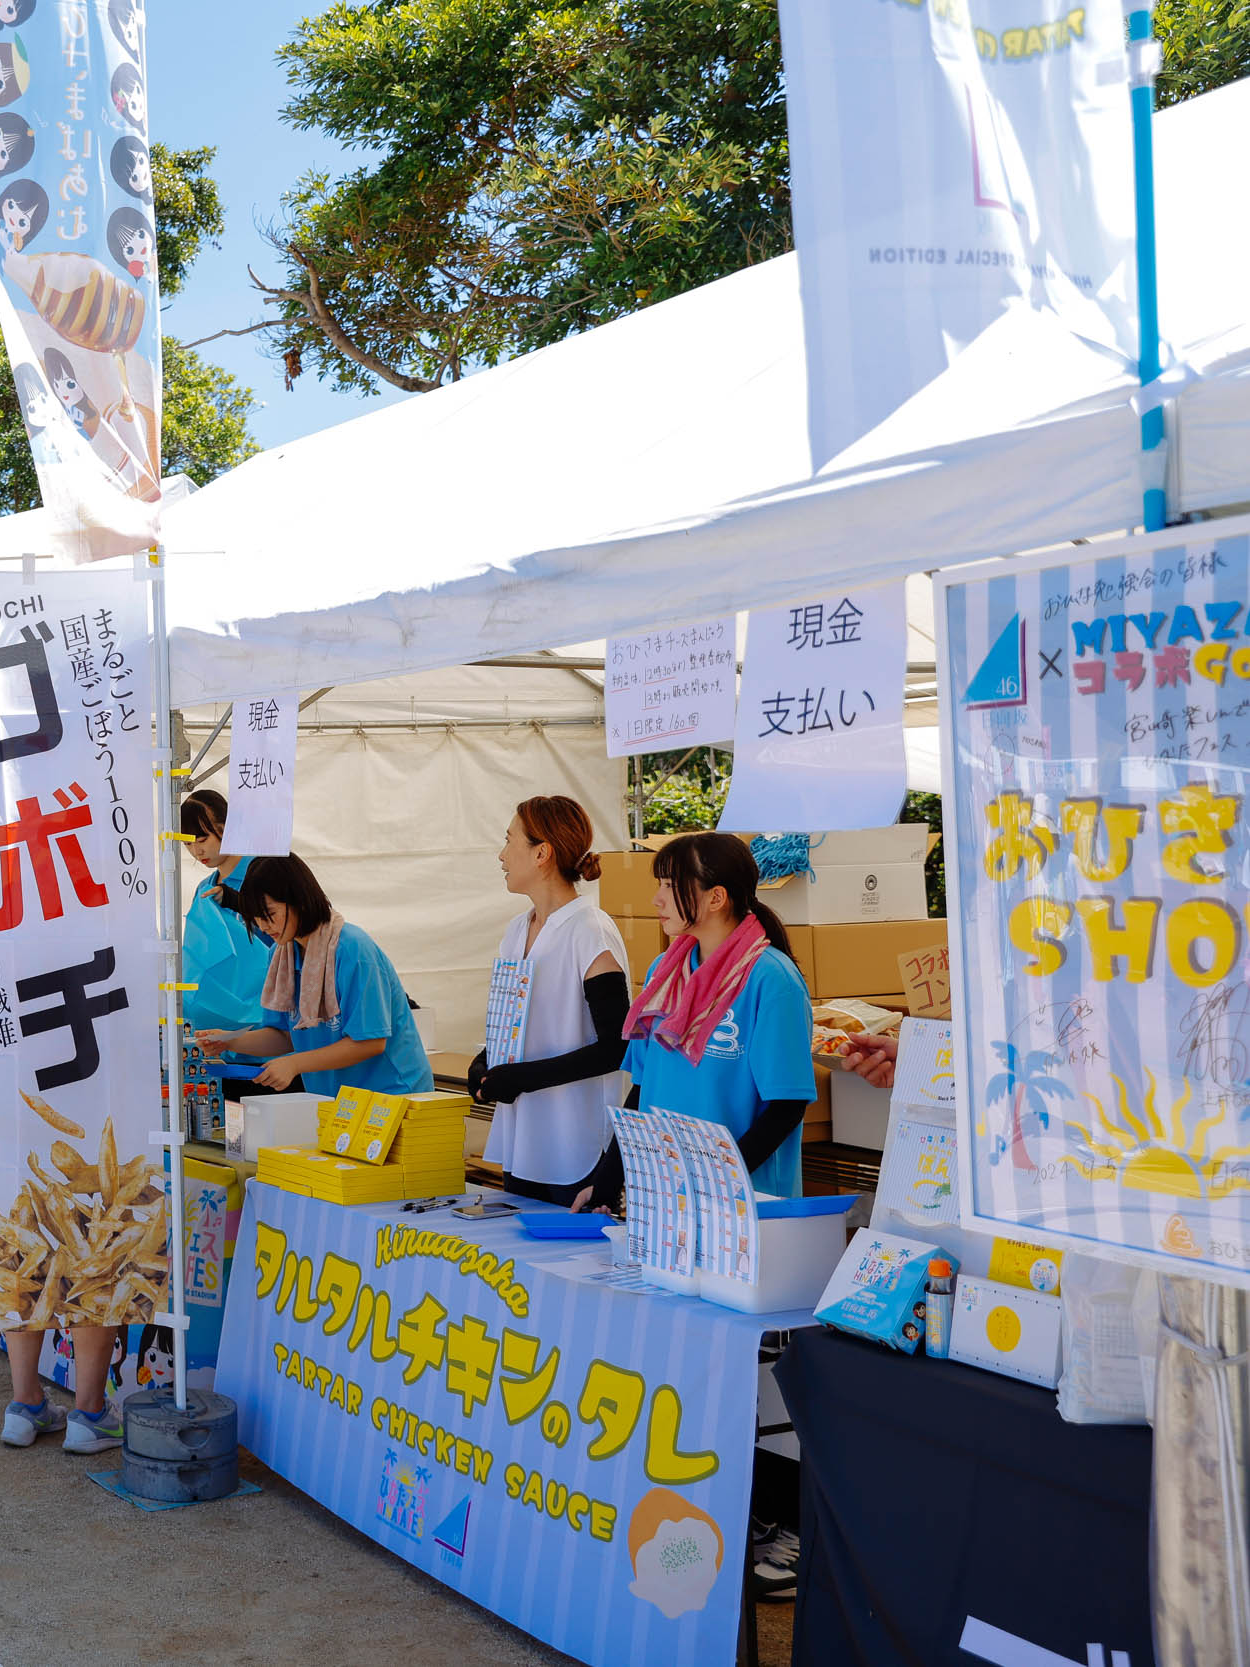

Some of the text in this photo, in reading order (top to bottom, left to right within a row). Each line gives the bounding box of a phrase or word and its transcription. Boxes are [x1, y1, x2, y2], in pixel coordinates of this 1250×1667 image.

[786, 597, 864, 650] 現金
[1071, 601, 1250, 657] MIYAZ
[92, 608, 140, 733] まるごと
[996, 676, 1018, 696] 46
[248, 698, 280, 732] 現金
[758, 687, 875, 738] 支払い
[60, 615, 148, 898] 国産ごぼう100%
[238, 759, 284, 791] 支払い
[984, 780, 1241, 886] おひさ
[1008, 896, 1250, 988] SHO
[254, 1221, 720, 1485] タルタルチキンのタレ
[273, 1342, 617, 1542] TARTAR CHICKEN SAUCE
